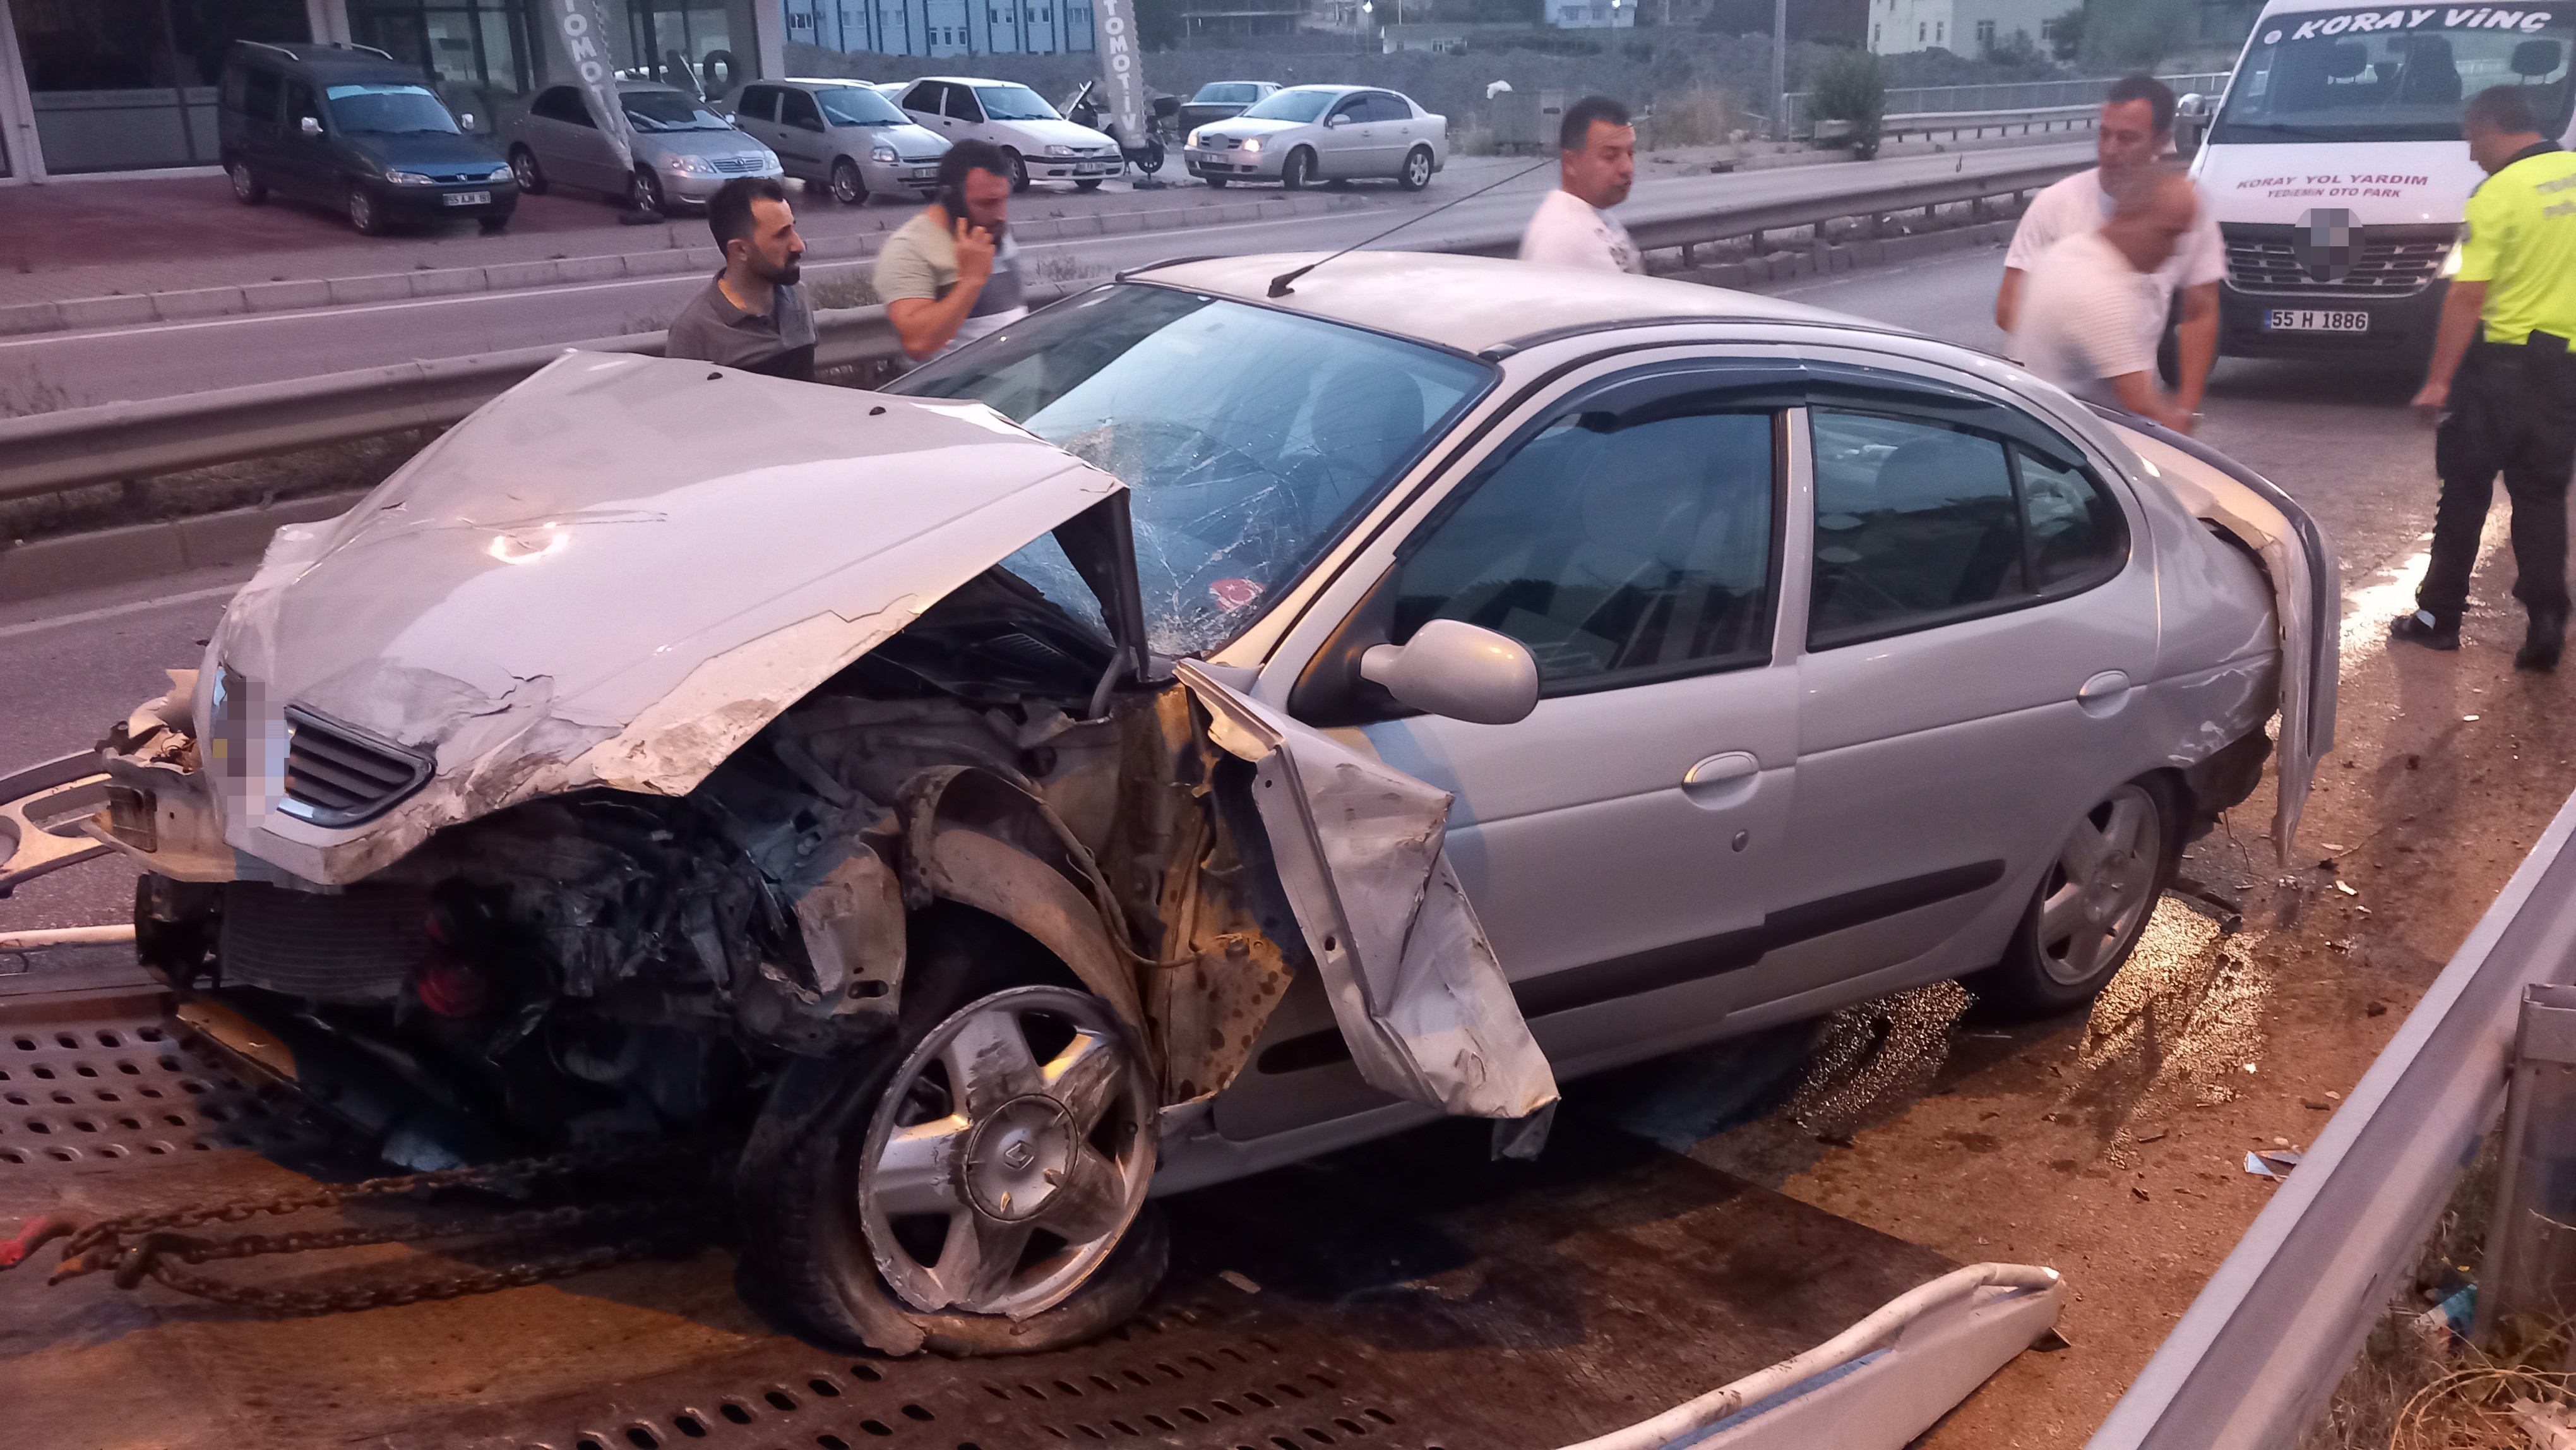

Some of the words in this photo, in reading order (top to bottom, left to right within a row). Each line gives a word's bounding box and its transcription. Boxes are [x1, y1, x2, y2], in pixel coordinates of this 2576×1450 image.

[2292, 9, 2436, 40] KORAY
[2237, 177, 2296, 189] KORAY
[2306, 175, 2342, 184] YOL
[2351, 174, 2428, 186] YARDIM
[2329, 188, 2359, 196] OTO
[2362, 188, 2402, 198] PARK
[2272, 311, 2294, 327] 55
[2301, 312, 2313, 328] H
[2322, 313, 2366, 329] 1886
